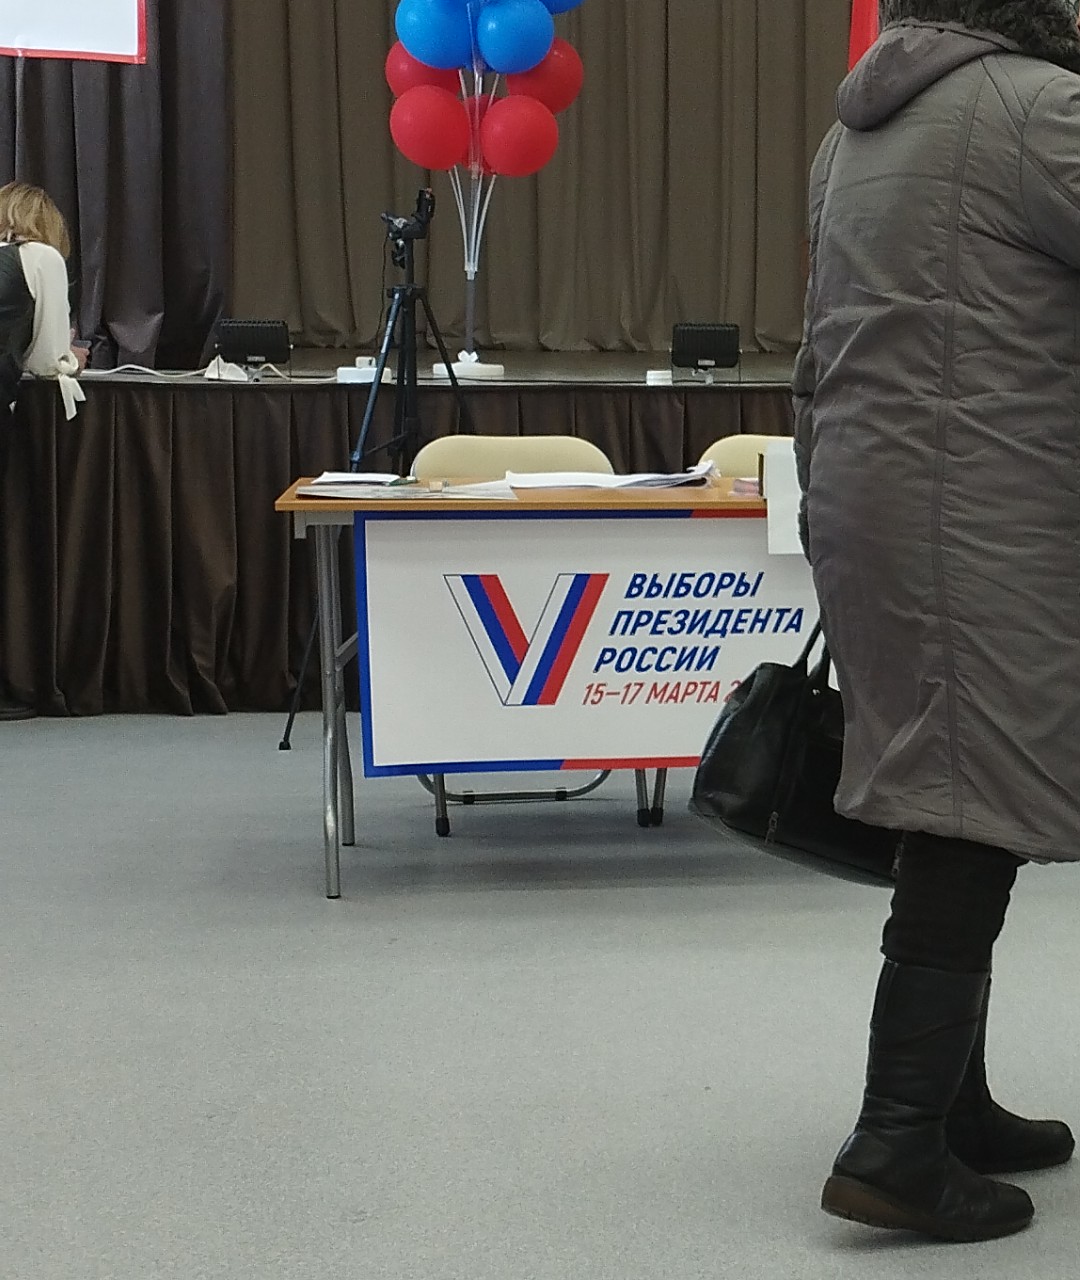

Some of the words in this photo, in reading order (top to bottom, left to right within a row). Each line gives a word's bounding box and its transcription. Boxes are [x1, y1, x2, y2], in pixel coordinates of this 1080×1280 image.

[624, 571, 764, 599] ВЫБОРЫ
[608, 607, 804, 639] ПРЕЗИДЕНТА
[592, 645, 721, 673] РОССИИ
[645, 680, 721, 705] МАРТА
